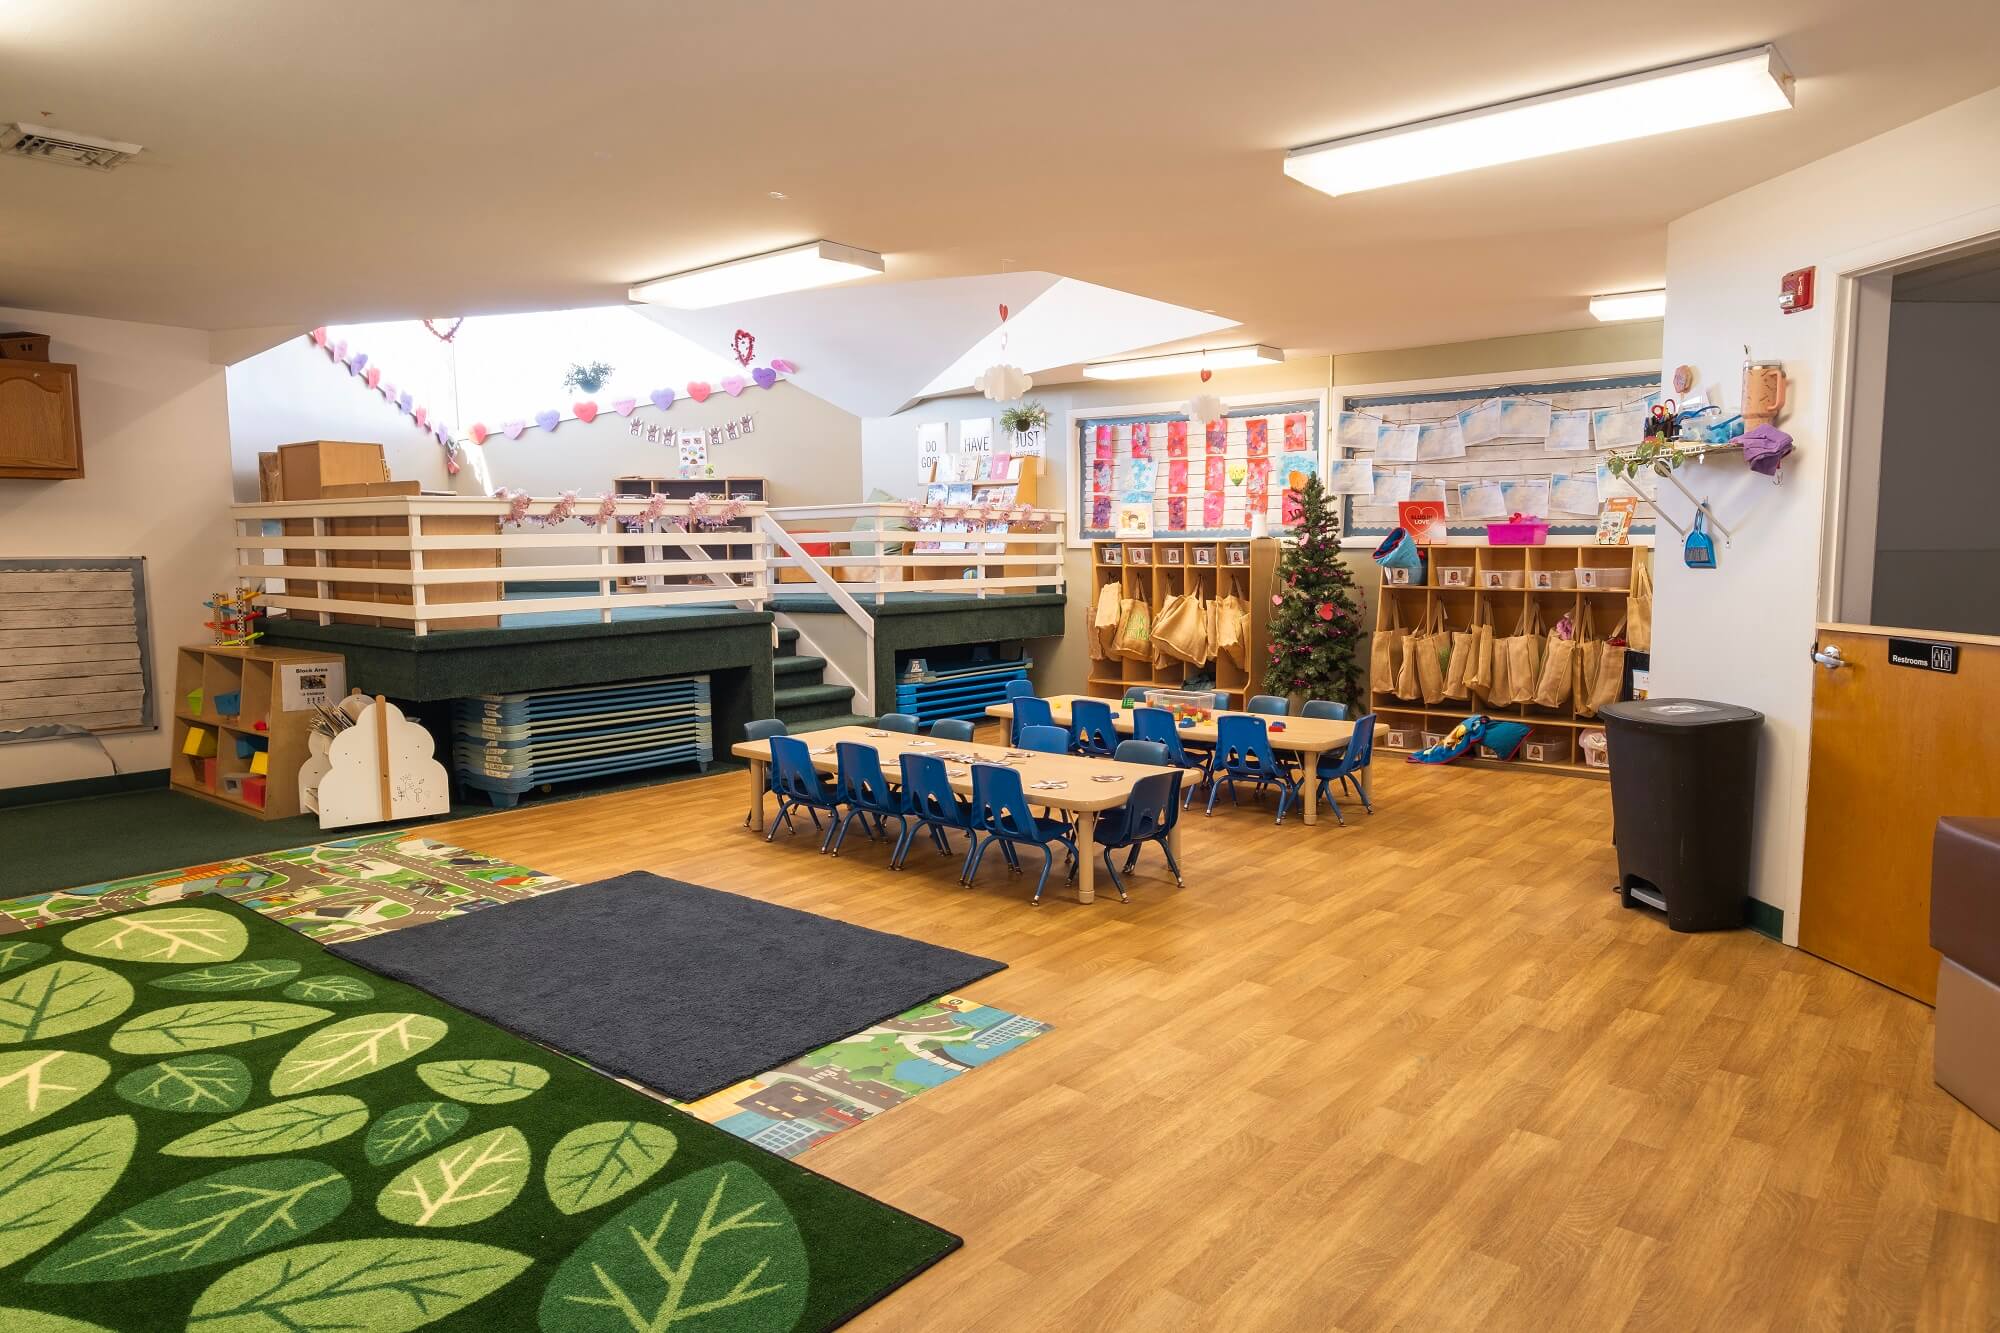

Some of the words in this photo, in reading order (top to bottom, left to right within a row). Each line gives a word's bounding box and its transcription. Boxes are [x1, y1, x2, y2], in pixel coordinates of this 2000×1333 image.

[964, 436, 990, 452] HAVE
[1016, 430, 1040, 448] JUST
[926, 440, 937, 452] DO
[921, 456, 940, 468] GOO
[1892, 655, 1929, 667] Restrooms
